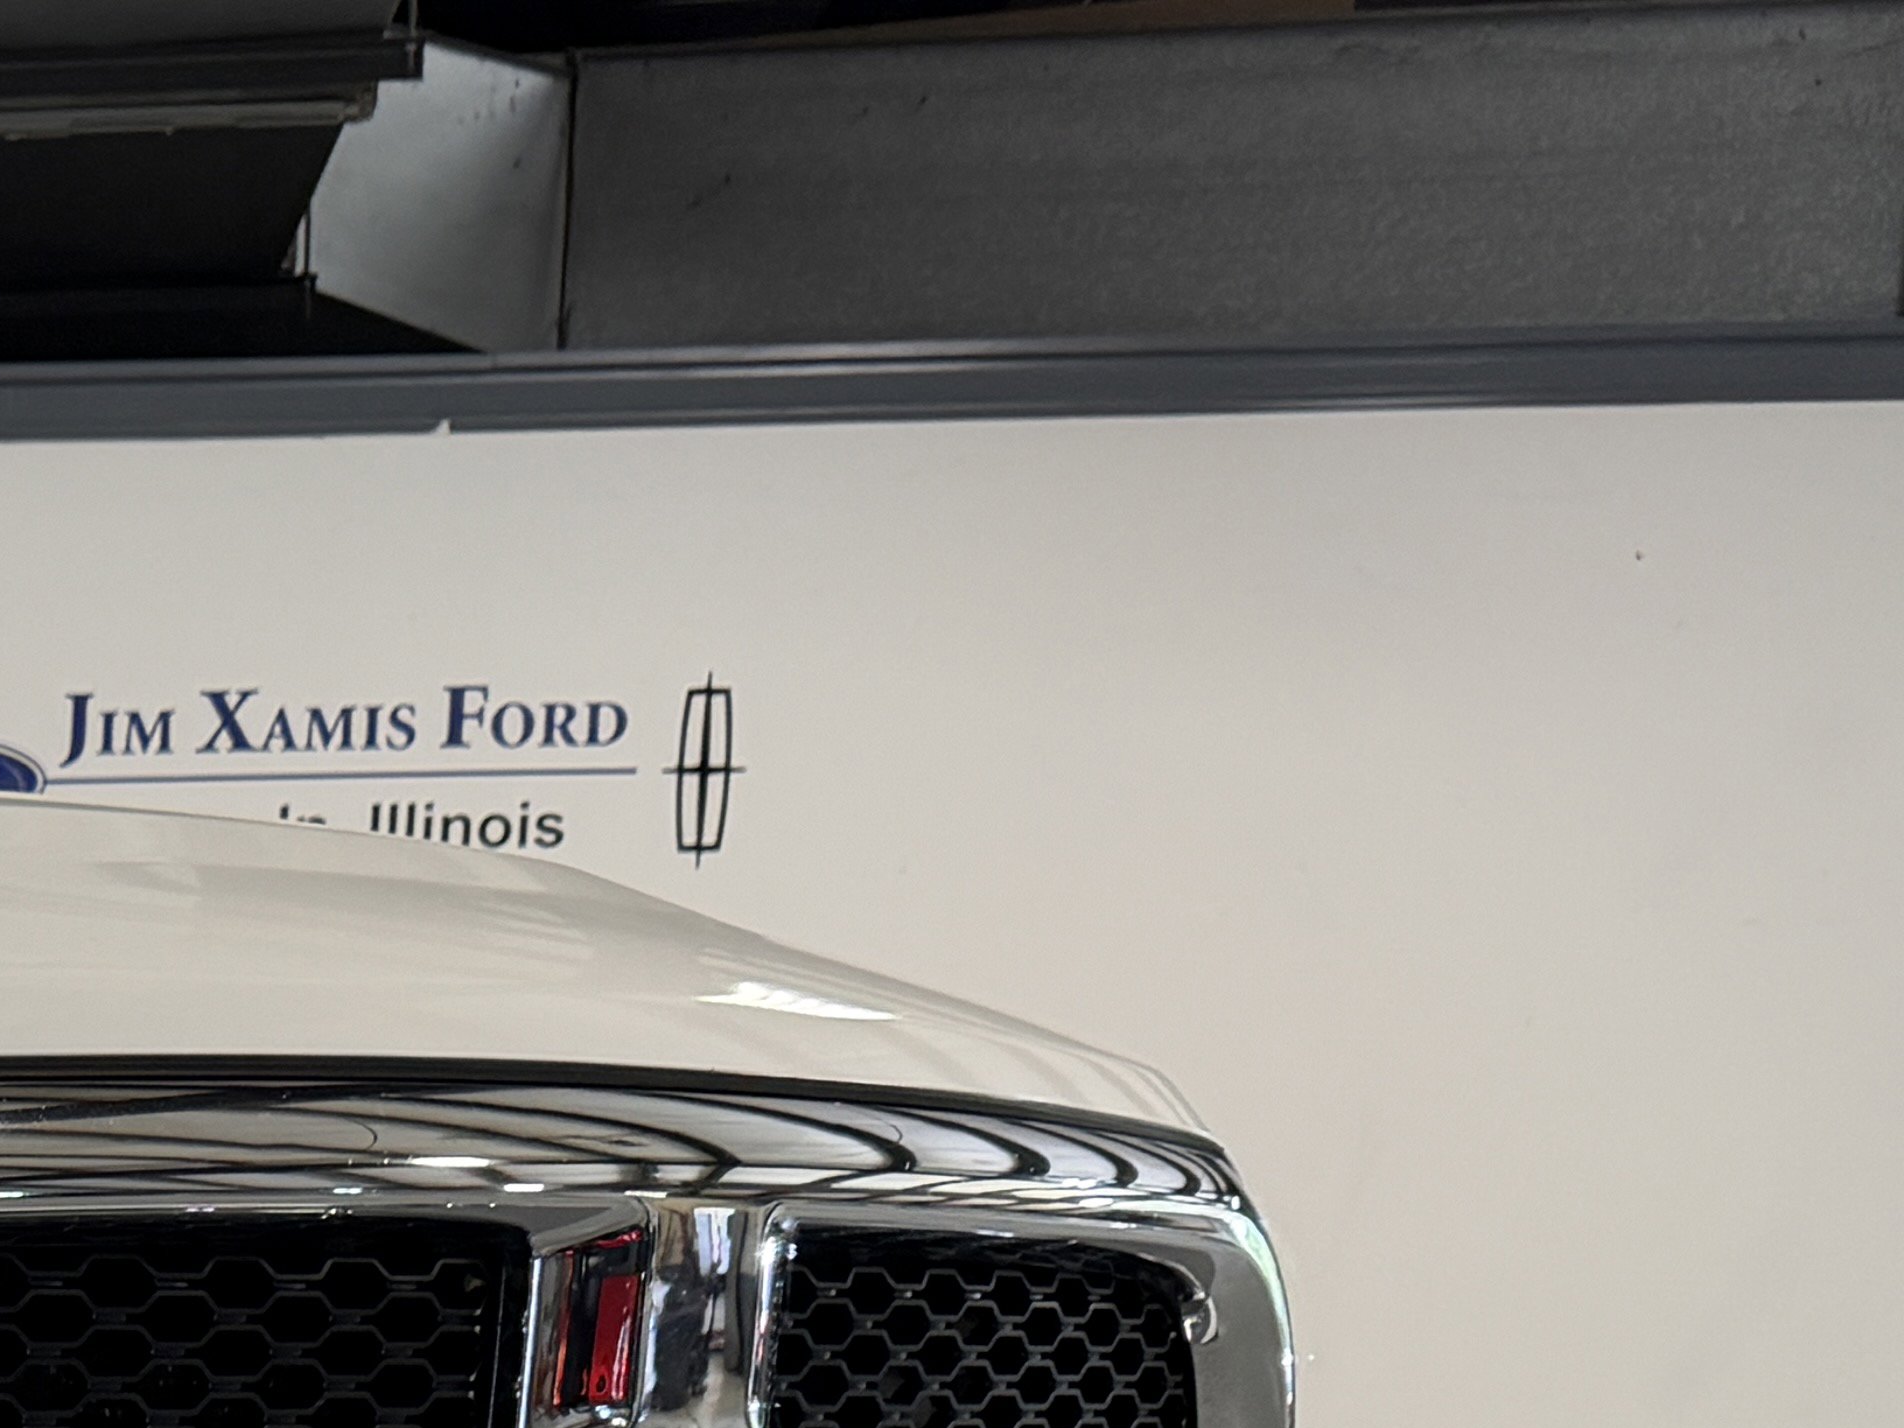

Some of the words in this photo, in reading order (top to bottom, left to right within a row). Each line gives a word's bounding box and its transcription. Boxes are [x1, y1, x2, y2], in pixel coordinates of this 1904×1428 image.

[59, 691, 176, 767] JIM
[195, 688, 417, 753] XAMIS
[440, 685, 629, 749] FORD
[370, 800, 564, 848] Illinois
